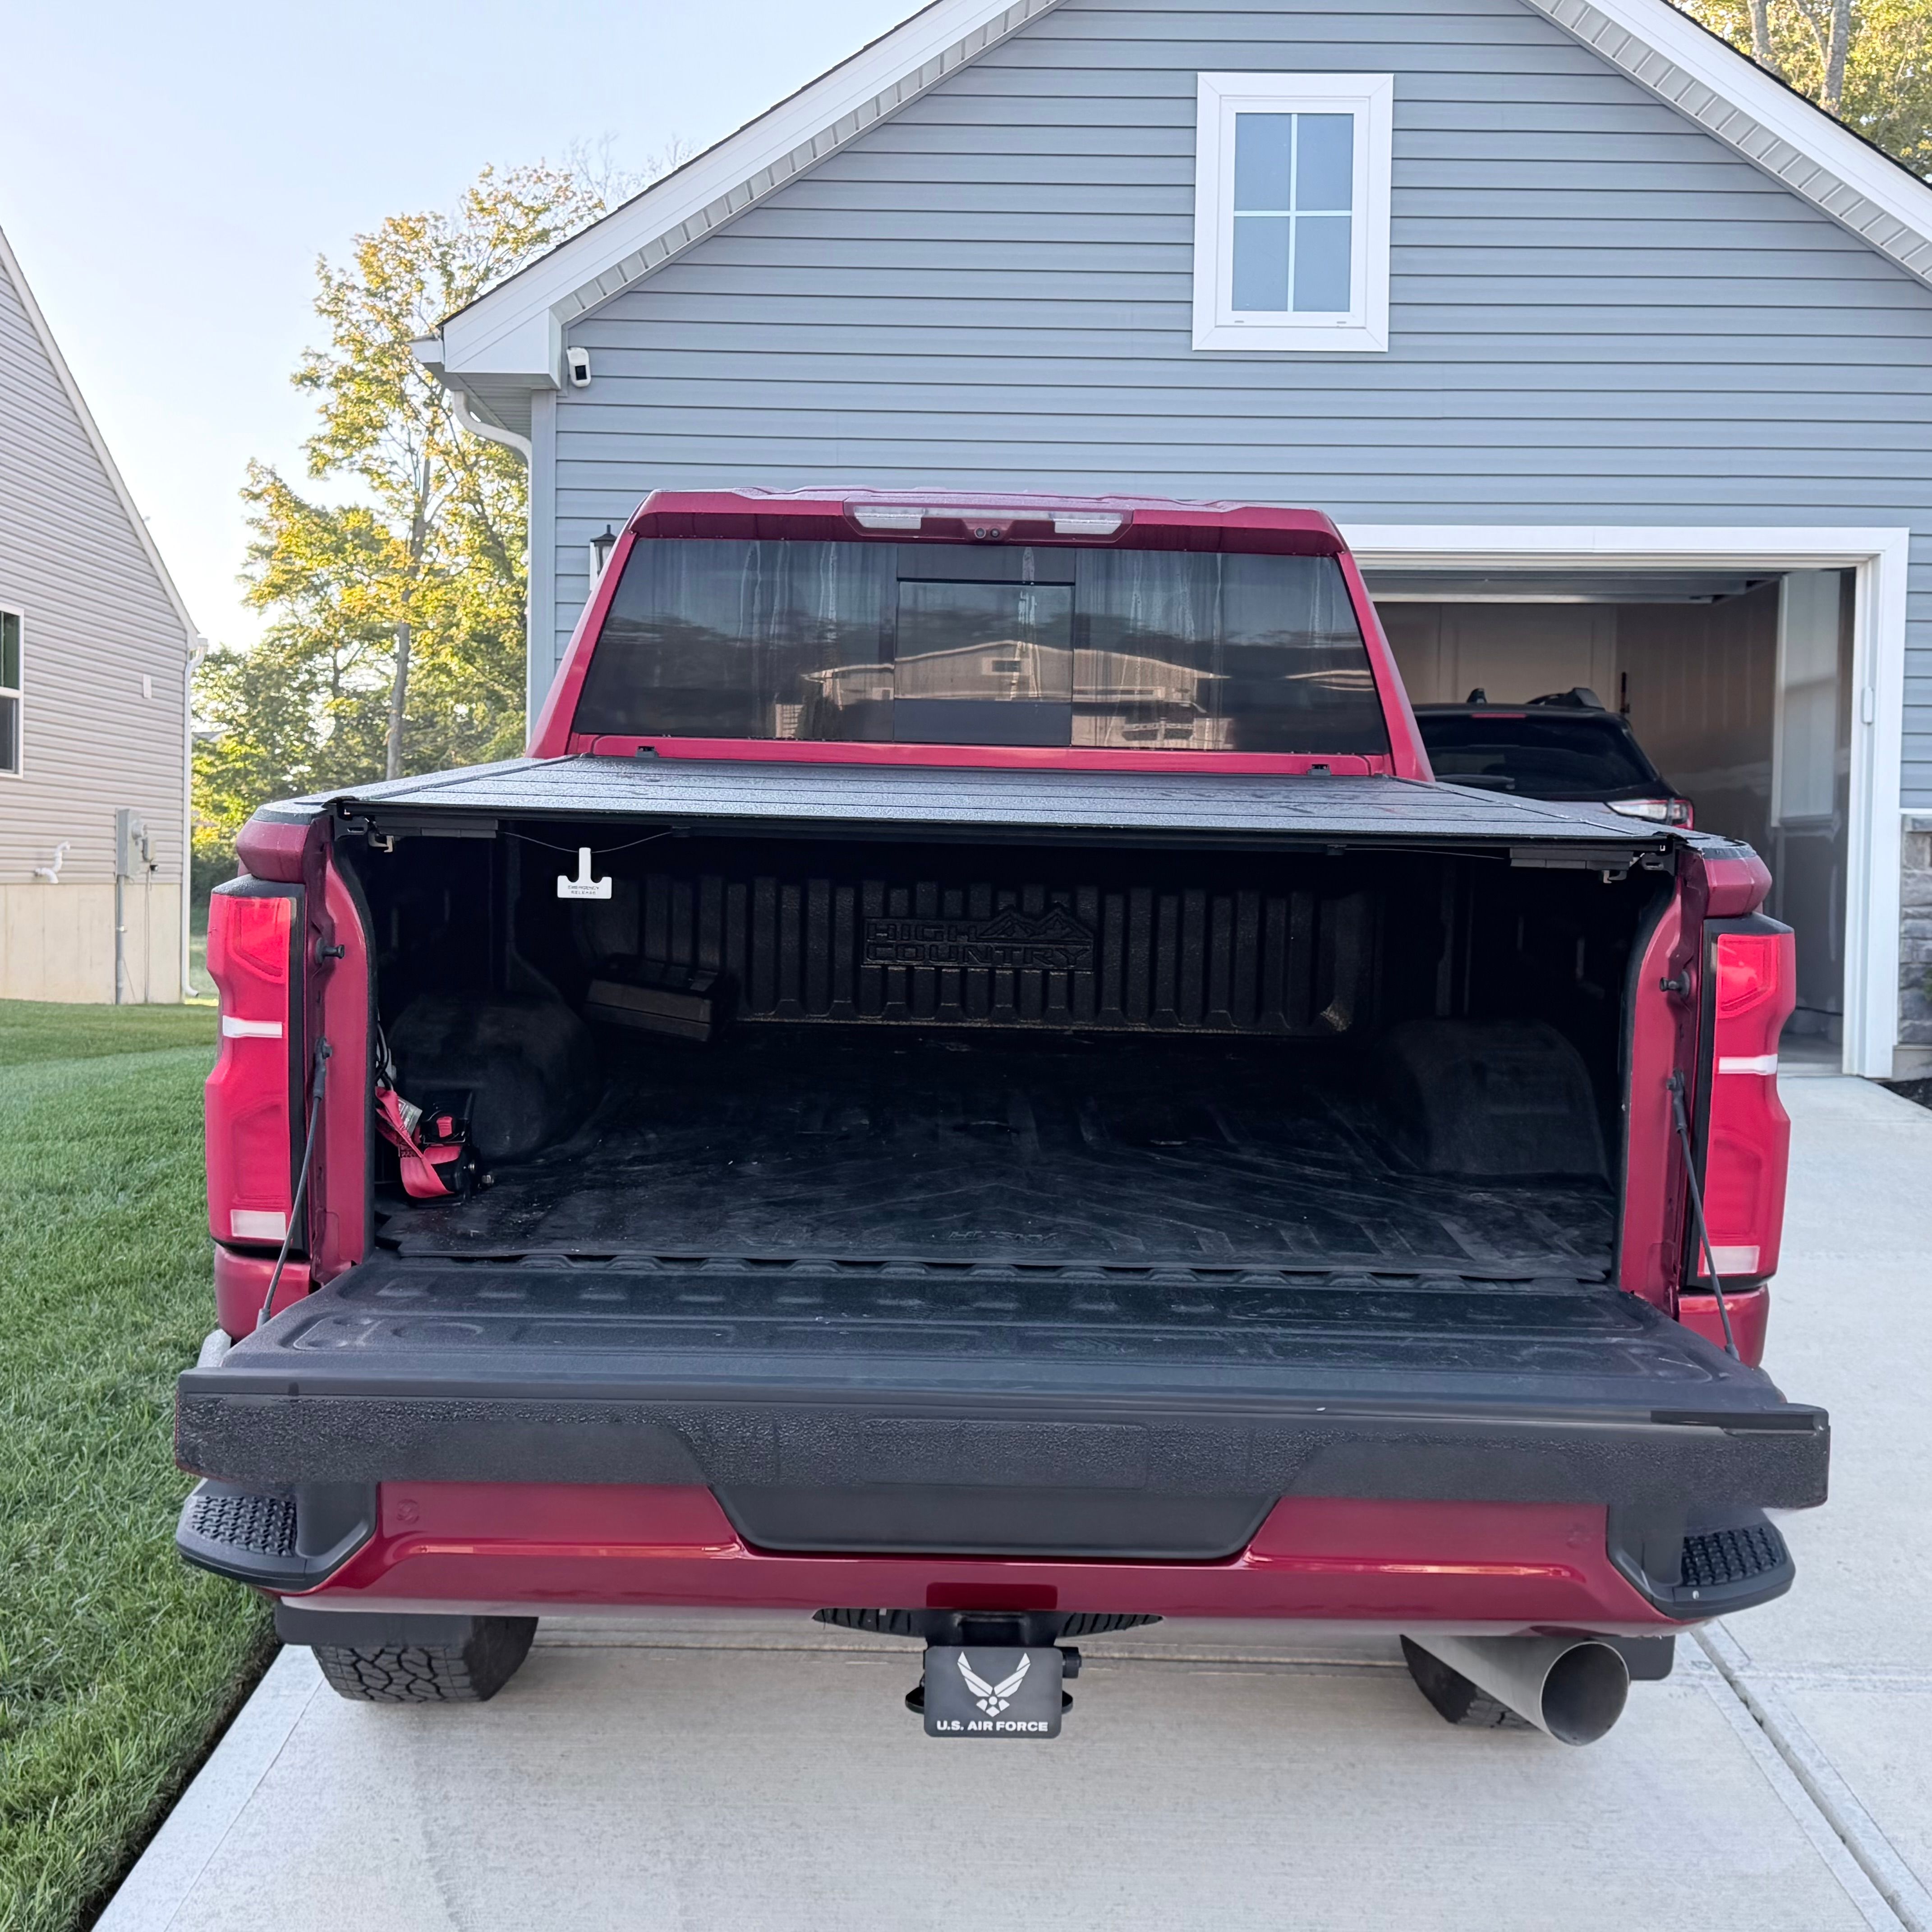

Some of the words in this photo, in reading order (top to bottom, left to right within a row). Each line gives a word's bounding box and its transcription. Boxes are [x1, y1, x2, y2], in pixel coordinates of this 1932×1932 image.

[867, 923, 977, 942] HIGH
[866, 943, 1091, 967] COUNTRY
[936, 1720, 965, 1731] U.S.
[967, 1720, 993, 1731] AIR
[996, 1721, 1049, 1732] FORCE
